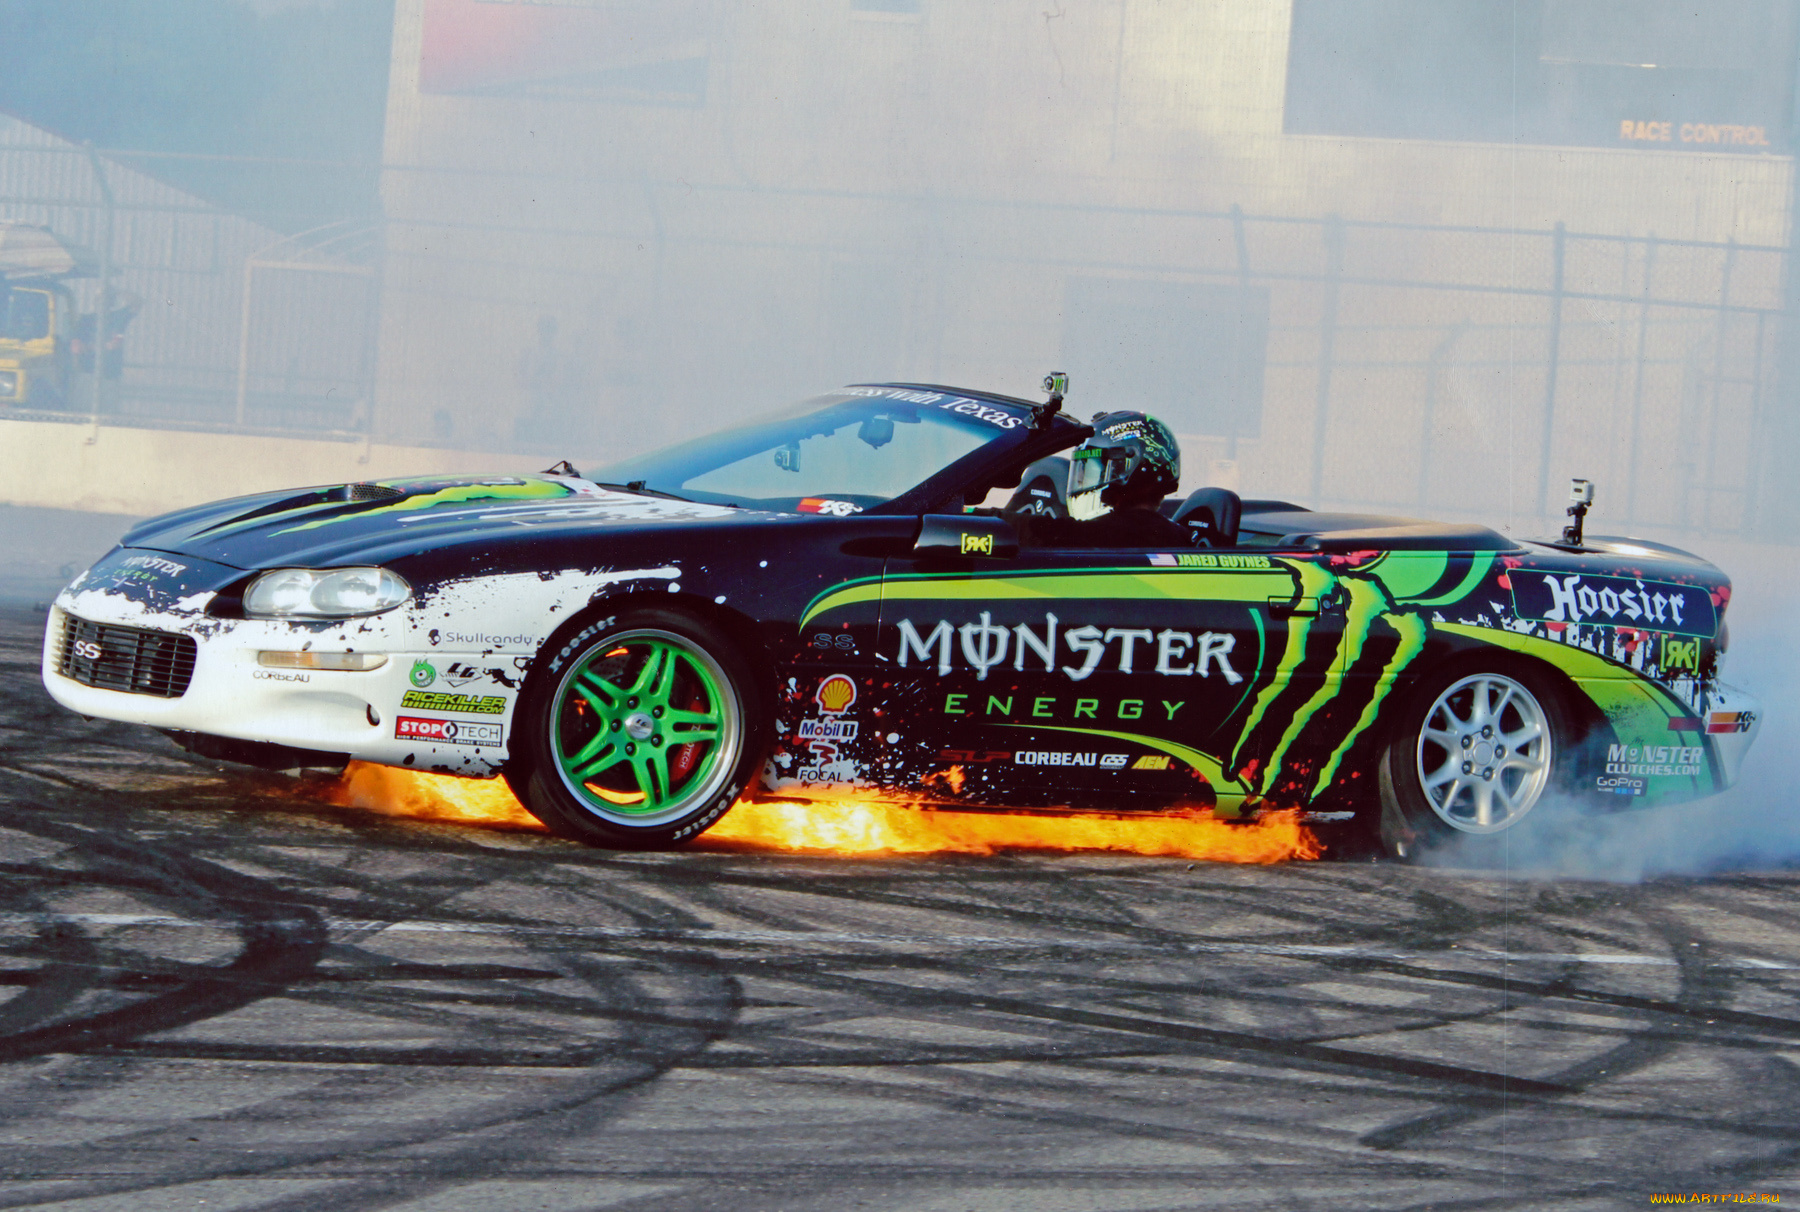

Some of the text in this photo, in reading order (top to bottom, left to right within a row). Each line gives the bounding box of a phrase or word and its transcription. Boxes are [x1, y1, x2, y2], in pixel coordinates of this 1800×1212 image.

[1620, 119, 1771, 146] RACE CONTROL
[938, 396, 1022, 429] Texas
[1178, 554, 1271, 568] JARED GUYNES
[1543, 574, 1685, 626] Hoosier
[446, 632, 532, 646] Skullcandy
[75, 640, 104, 659] SS
[897, 610, 1243, 685] MONSTER
[253, 671, 310, 683] CORBEAU
[402, 691, 506, 706] RICEKILLER
[944, 694, 1185, 720] ENERGY
[801, 722, 839, 736] Mobil
[1014, 751, 1098, 766] CORBEAU
[1131, 756, 1171, 770] AEM
[799, 769, 843, 782] FOCAL
[1606, 763, 1700, 775] CLUTCHES.COM
[1597, 777, 1642, 787] GoPro
